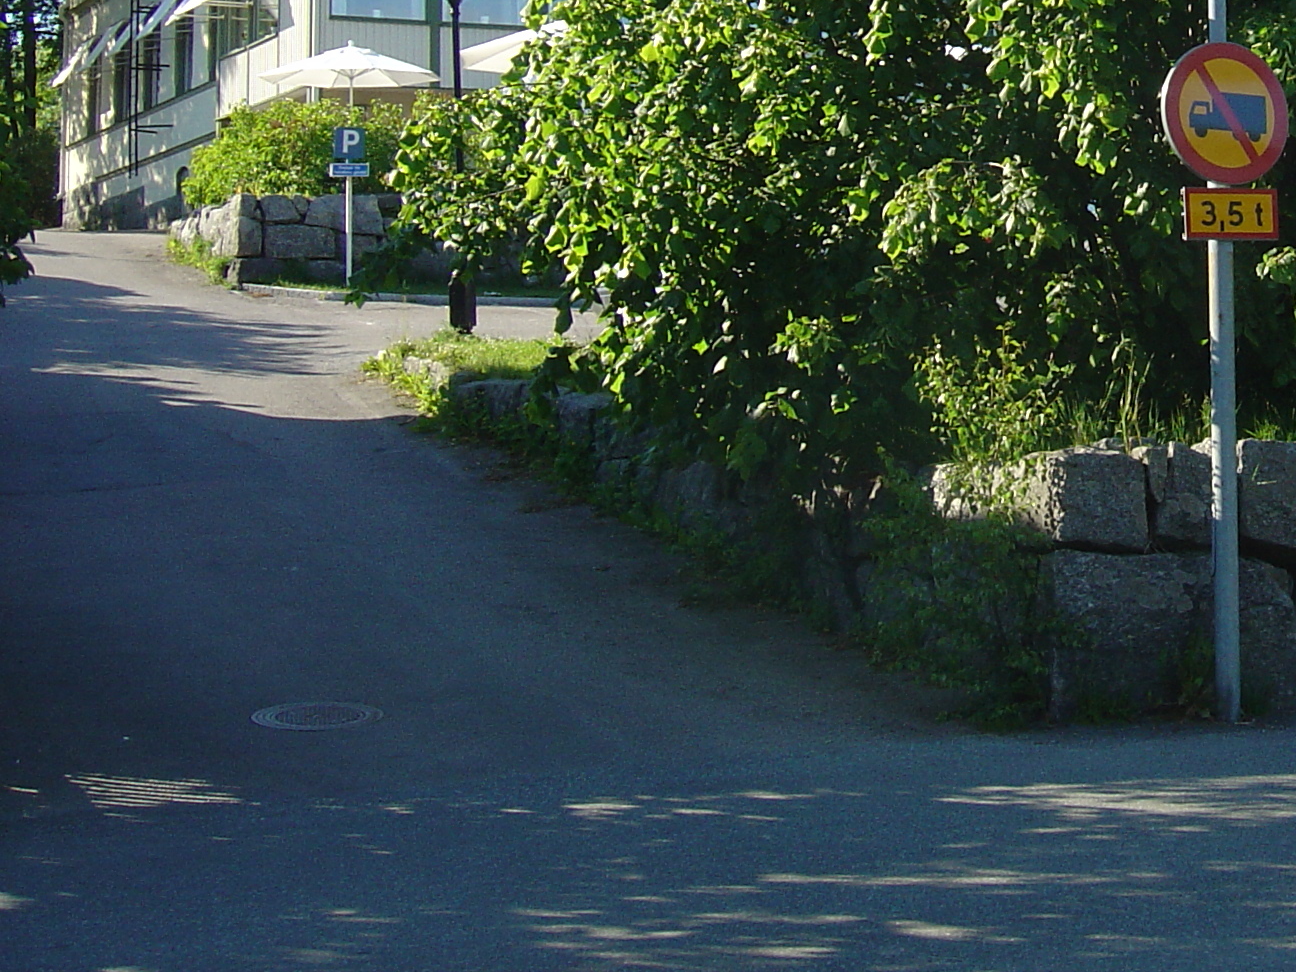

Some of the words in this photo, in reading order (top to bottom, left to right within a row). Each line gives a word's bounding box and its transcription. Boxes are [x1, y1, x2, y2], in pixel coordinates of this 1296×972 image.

[342, 130, 360, 153] P
[1200, 200, 1245, 232] 3,5
[1254, 201, 1264, 227] t
